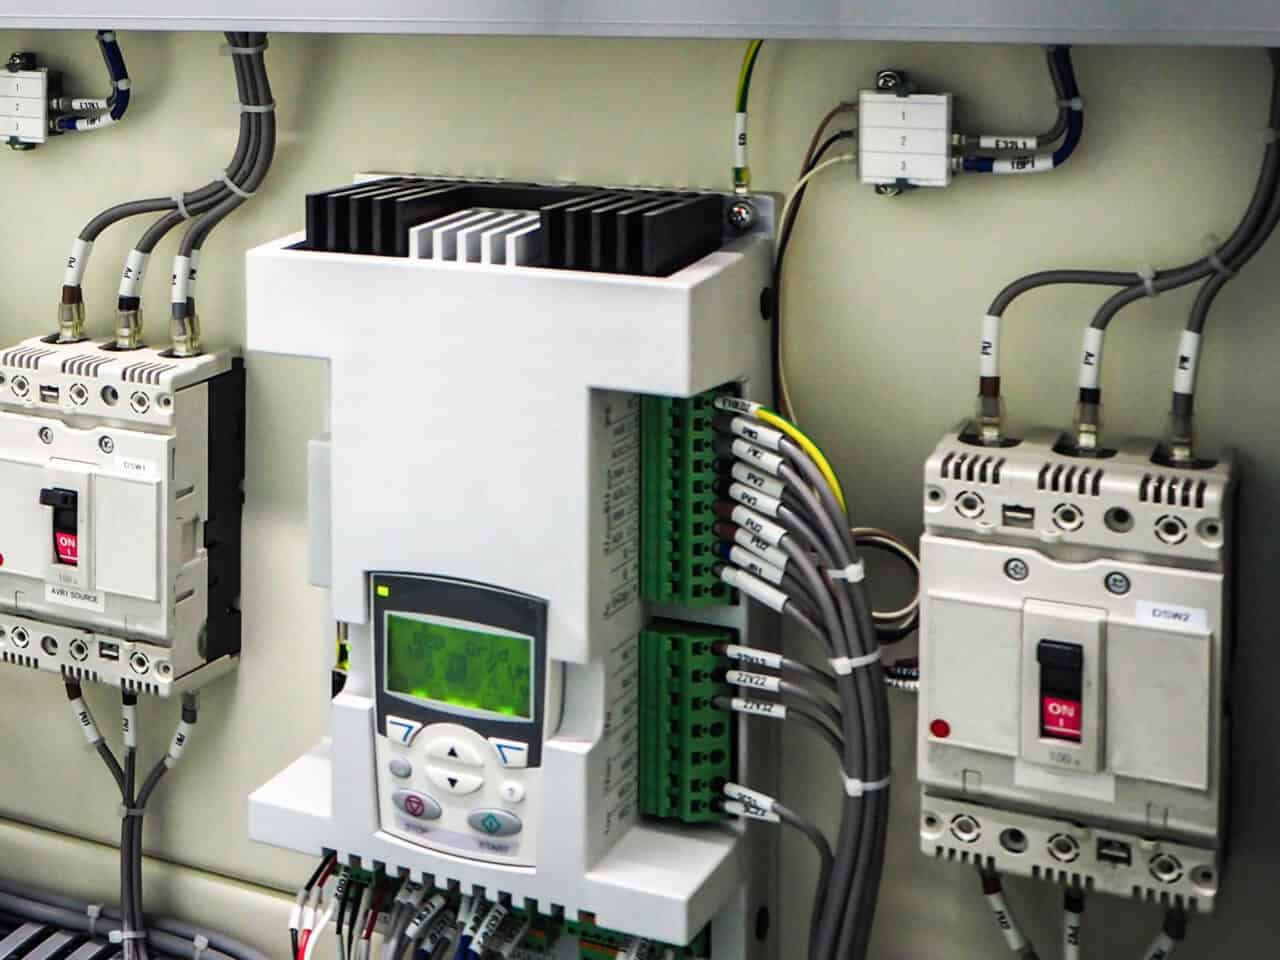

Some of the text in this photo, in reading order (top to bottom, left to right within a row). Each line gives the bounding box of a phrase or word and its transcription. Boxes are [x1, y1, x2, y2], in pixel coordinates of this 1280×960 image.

[59, 536, 77, 548] ON
[69, 590, 99, 604] SOURCE
[1151, 606, 1191, 624] DSW2
[1048, 700, 1075, 719] ON
